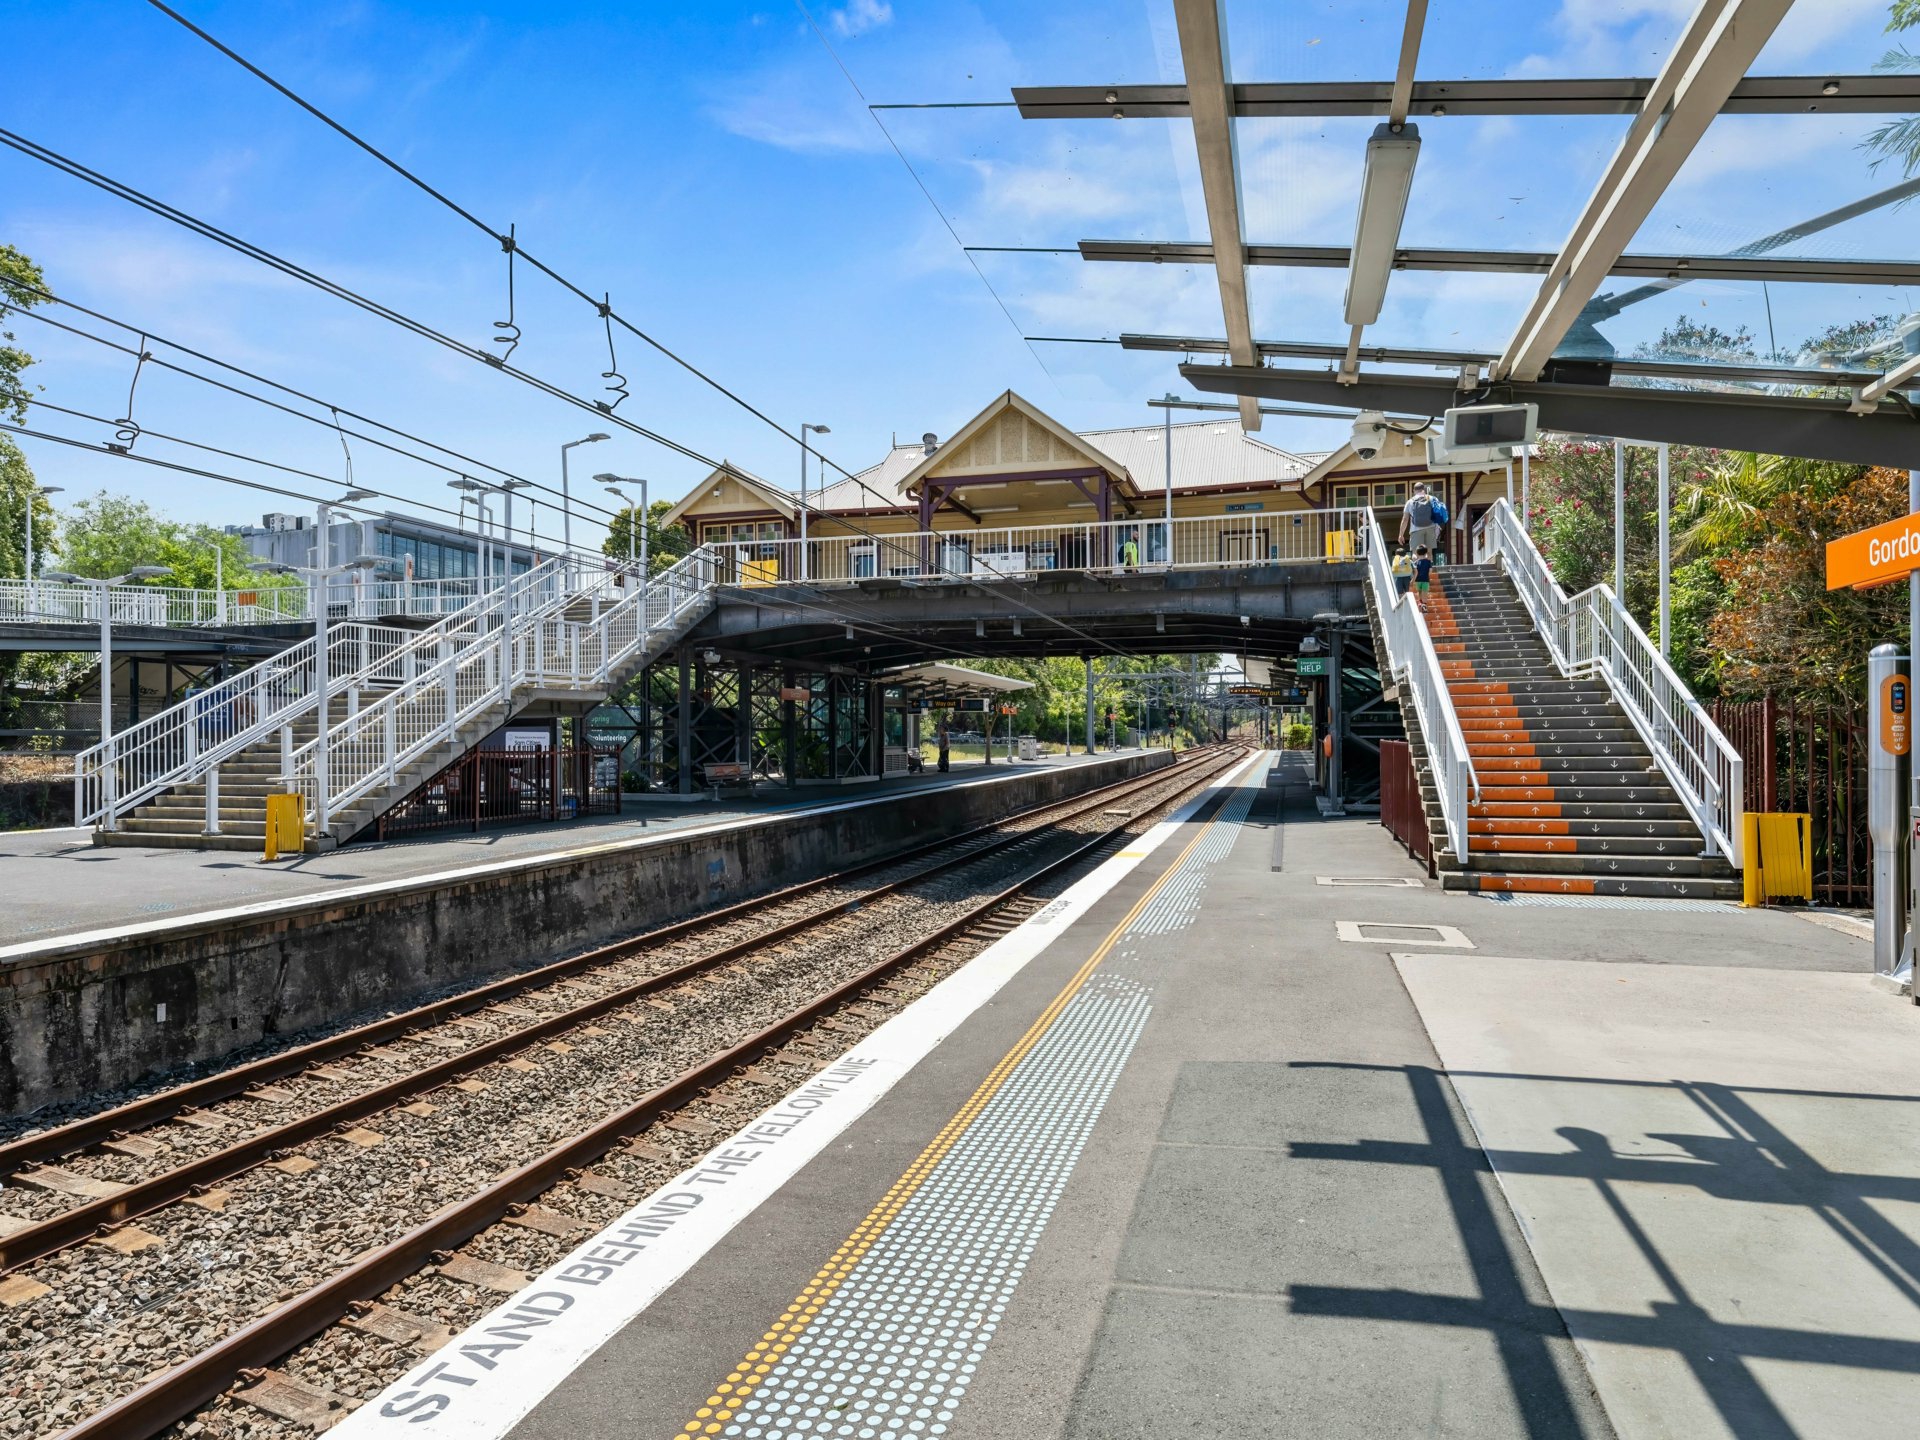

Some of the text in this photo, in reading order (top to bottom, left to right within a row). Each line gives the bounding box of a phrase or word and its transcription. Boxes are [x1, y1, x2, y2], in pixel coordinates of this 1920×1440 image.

[1869, 528, 1920, 566] Gordo
[379, 1057, 878, 1423] STAND BEHIND THE YELLOW LINE
